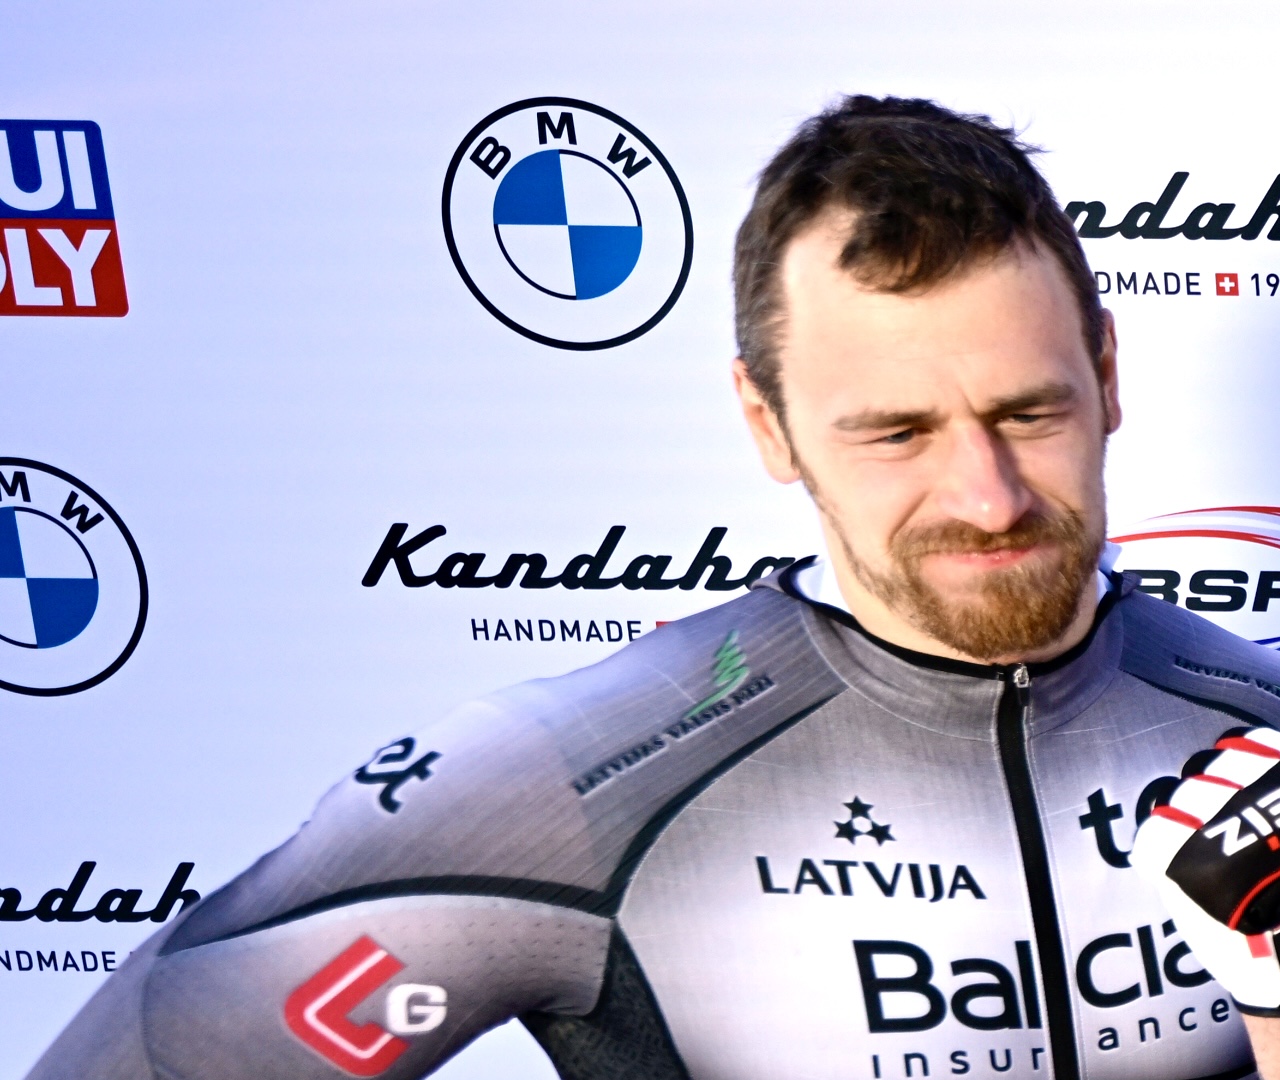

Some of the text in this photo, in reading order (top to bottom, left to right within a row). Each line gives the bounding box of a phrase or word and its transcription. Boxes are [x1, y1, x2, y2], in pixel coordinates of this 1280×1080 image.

[470, 111, 652, 180] BMW
[0, 229, 111, 307] LY
[1096, 271, 1201, 295] DMADE
[0, 471, 104, 535] MW
[362, 522, 796, 592] Kandaha
[471, 619, 643, 643] HANDMADE
[355, 737, 440, 813] et
[0, 861, 201, 923] ndah
[756, 855, 988, 903] LATVIJA
[0, 950, 117, 972] NDMADE
[284, 934, 447, 1077] LG
[872, 998, 1230, 1079] insurance
